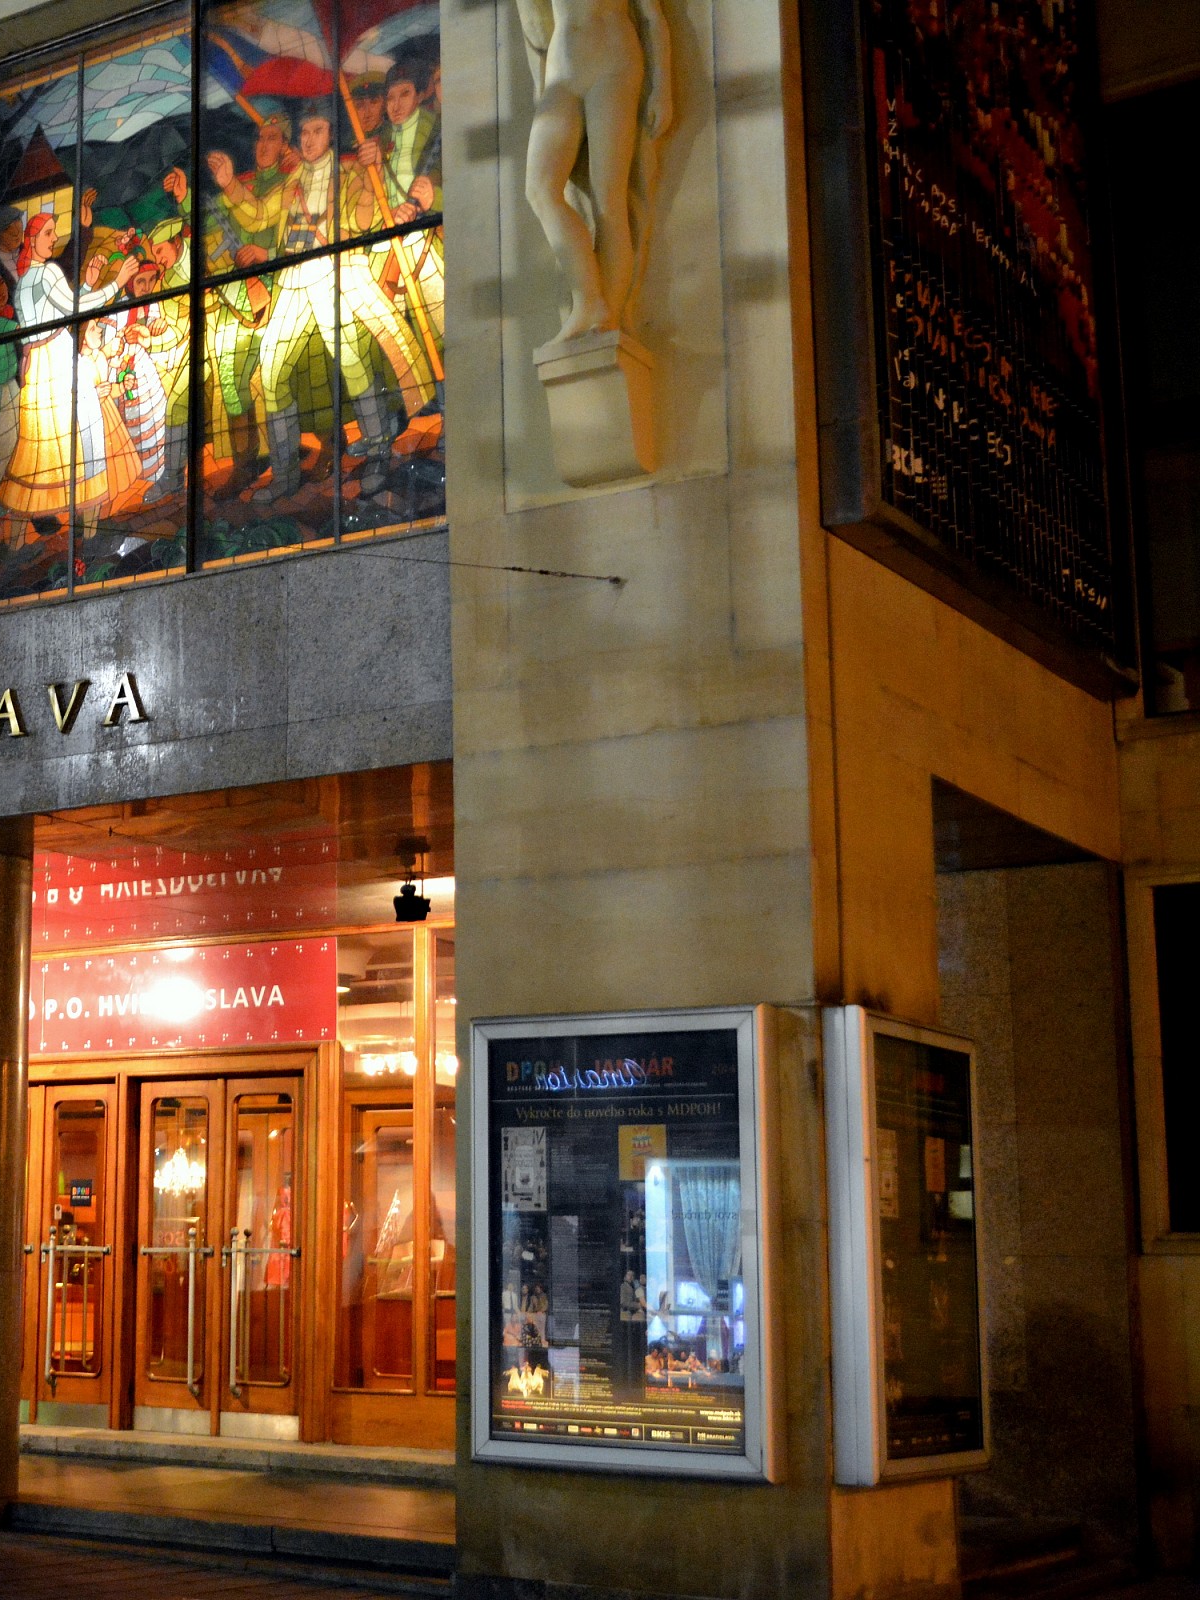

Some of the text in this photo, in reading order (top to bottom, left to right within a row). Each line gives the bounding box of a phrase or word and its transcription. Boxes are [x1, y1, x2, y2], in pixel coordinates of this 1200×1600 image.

[44, 997, 91, 1020] P.O.
[97, 984, 286, 1017] HVISLAVA
[566, 1104, 581, 1118] do
[627, 1103, 654, 1116] roka
